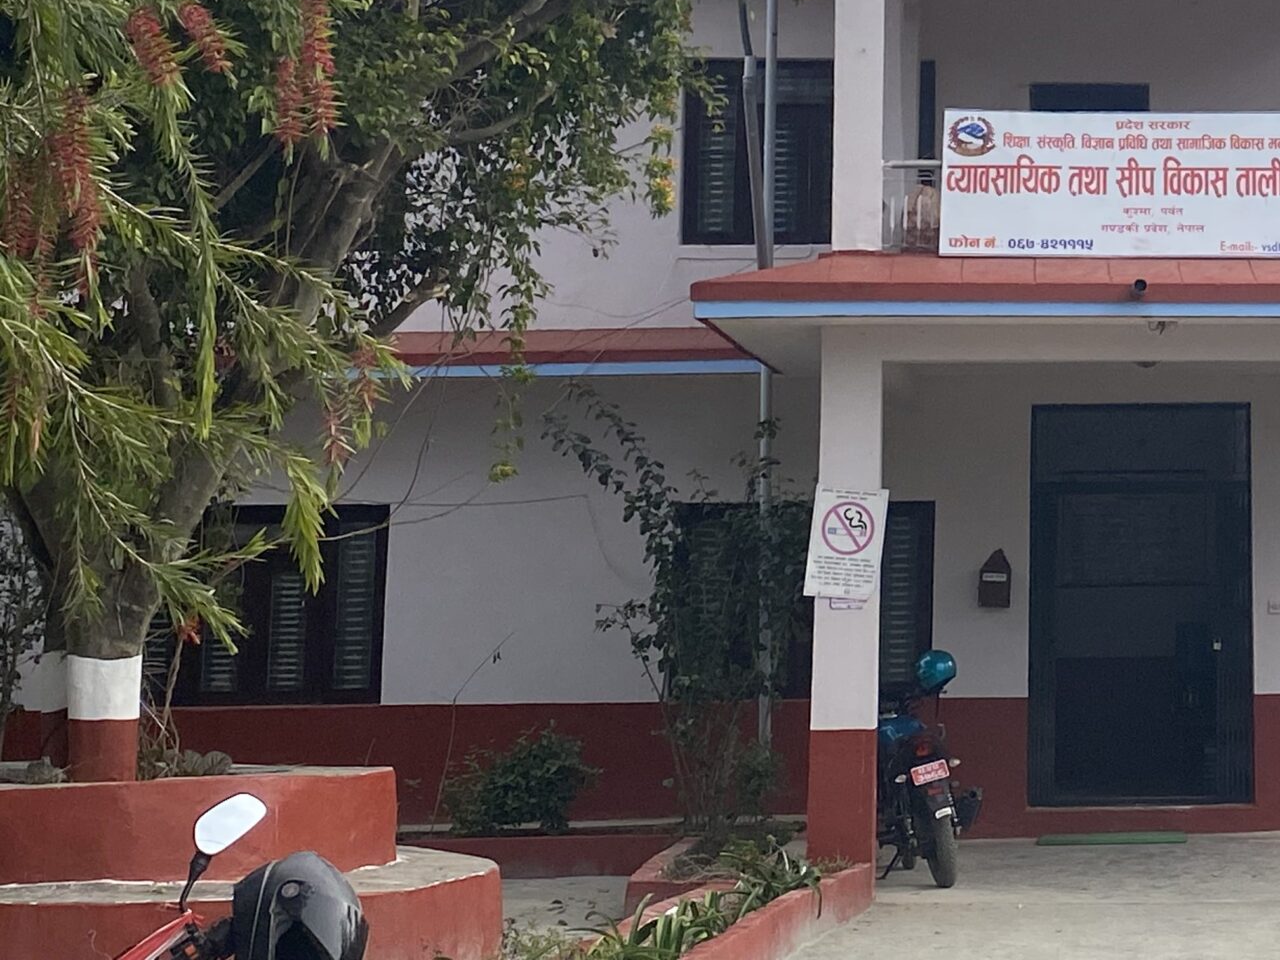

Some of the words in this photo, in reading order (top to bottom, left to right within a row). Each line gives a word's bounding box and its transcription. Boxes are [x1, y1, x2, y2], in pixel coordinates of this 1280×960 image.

[1116, 119, 1143, 130] प्रदेश
[1148, 120, 1190, 130] सरकार
[1082, 134, 1114, 150] विज्ञान
[1118, 134, 1148, 150] प्रविधि
[1152, 137, 1172, 150] तथा
[1177, 134, 1226, 151] सामाजिक
[1230, 135, 1265, 151] विकास
[946, 154, 1062, 196] व्यावसायिक
[1069, 166, 1109, 197] तथा
[1116, 157, 1156, 198] सीप
[1163, 156, 1229, 198] विकास
[948, 235, 980, 248] फोन
